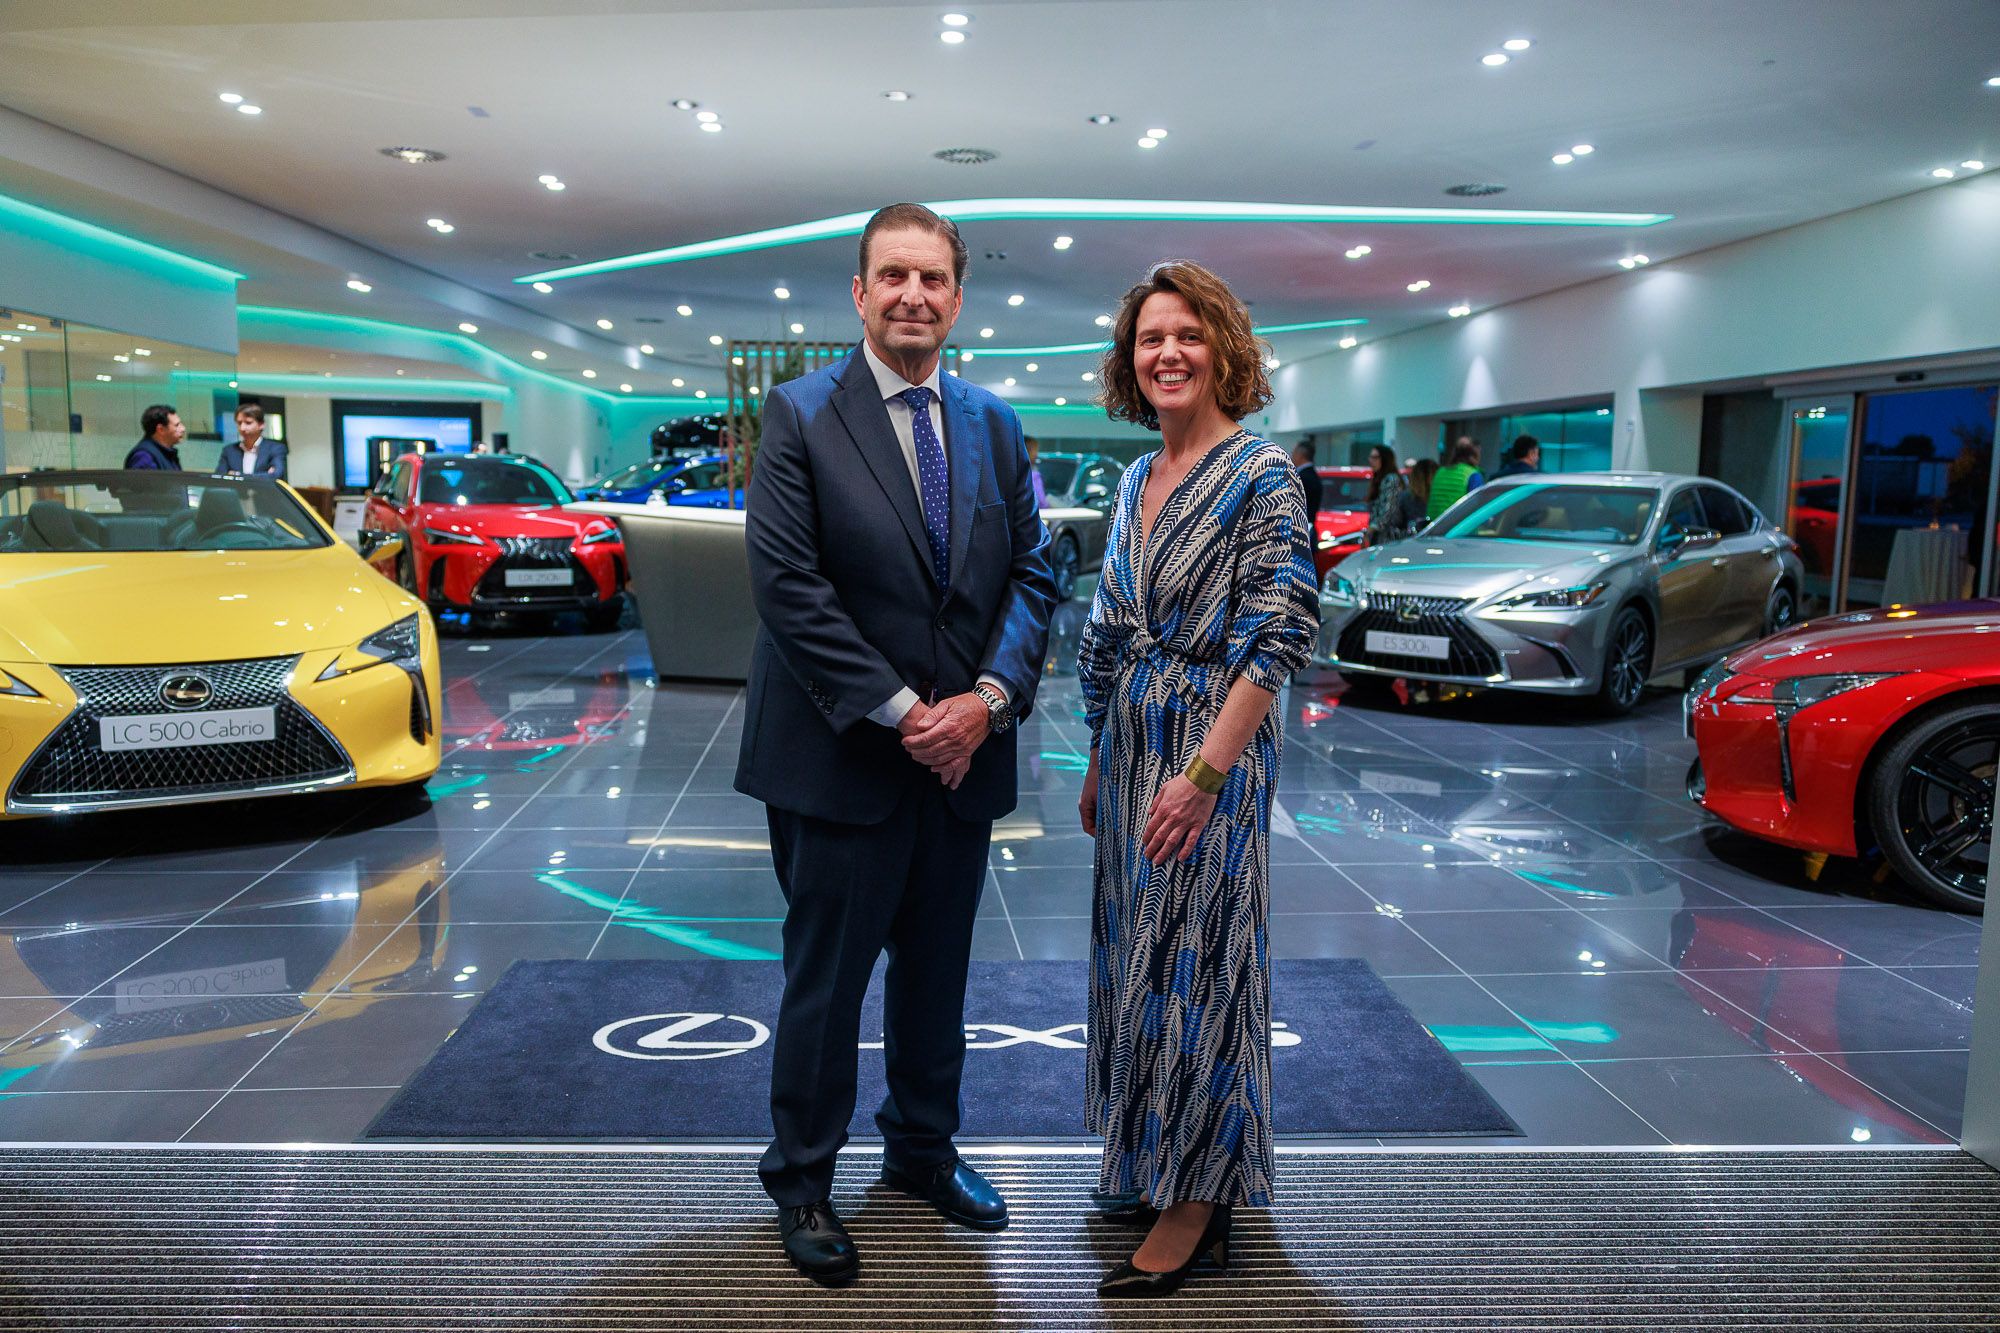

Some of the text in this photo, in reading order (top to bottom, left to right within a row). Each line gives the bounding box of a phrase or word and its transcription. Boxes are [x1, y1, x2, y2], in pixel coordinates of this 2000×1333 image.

[1383, 635, 1430, 654] ES 300h
[112, 718, 264, 745] LC 500 Cabrio
